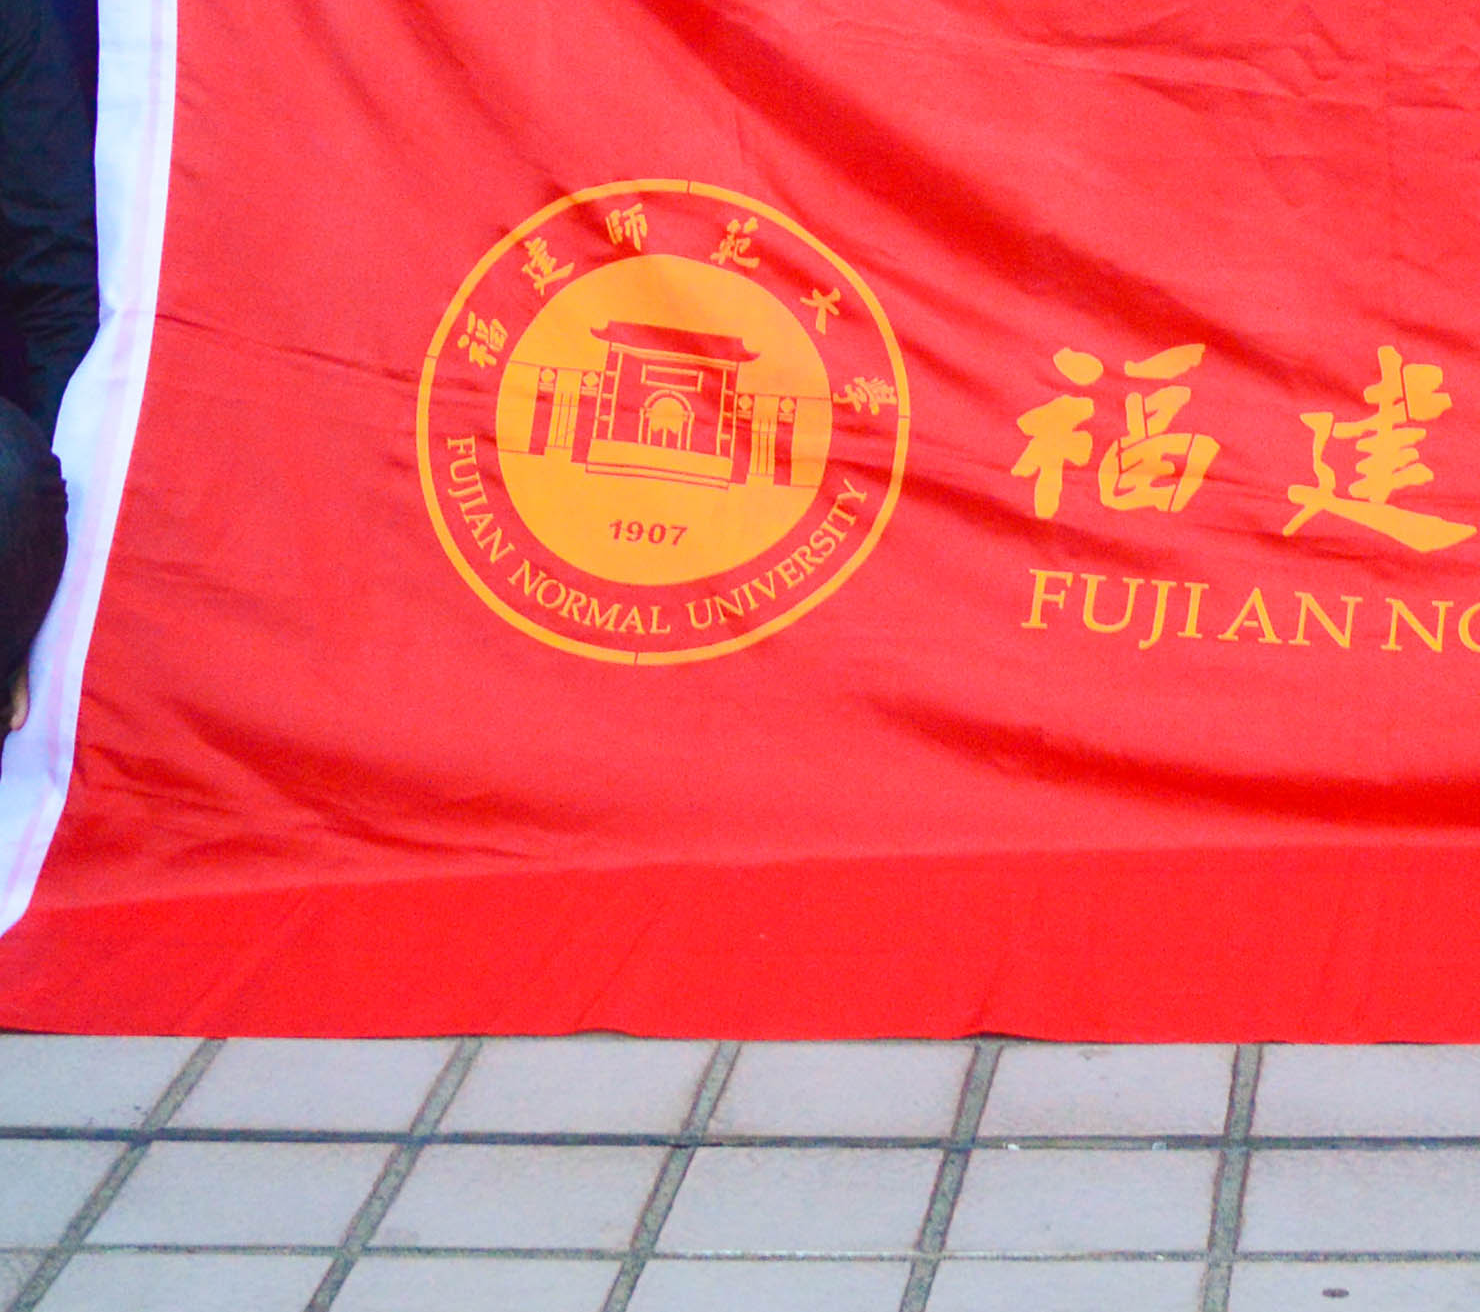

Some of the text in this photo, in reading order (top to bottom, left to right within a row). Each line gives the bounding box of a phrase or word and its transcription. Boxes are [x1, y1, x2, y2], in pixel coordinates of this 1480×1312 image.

[446, 435, 868, 635] FUJIAN NORMAL UNIVERSITY
[608, 519, 689, 547] 1907
[1021, 568, 1363, 650] FUJIAN
